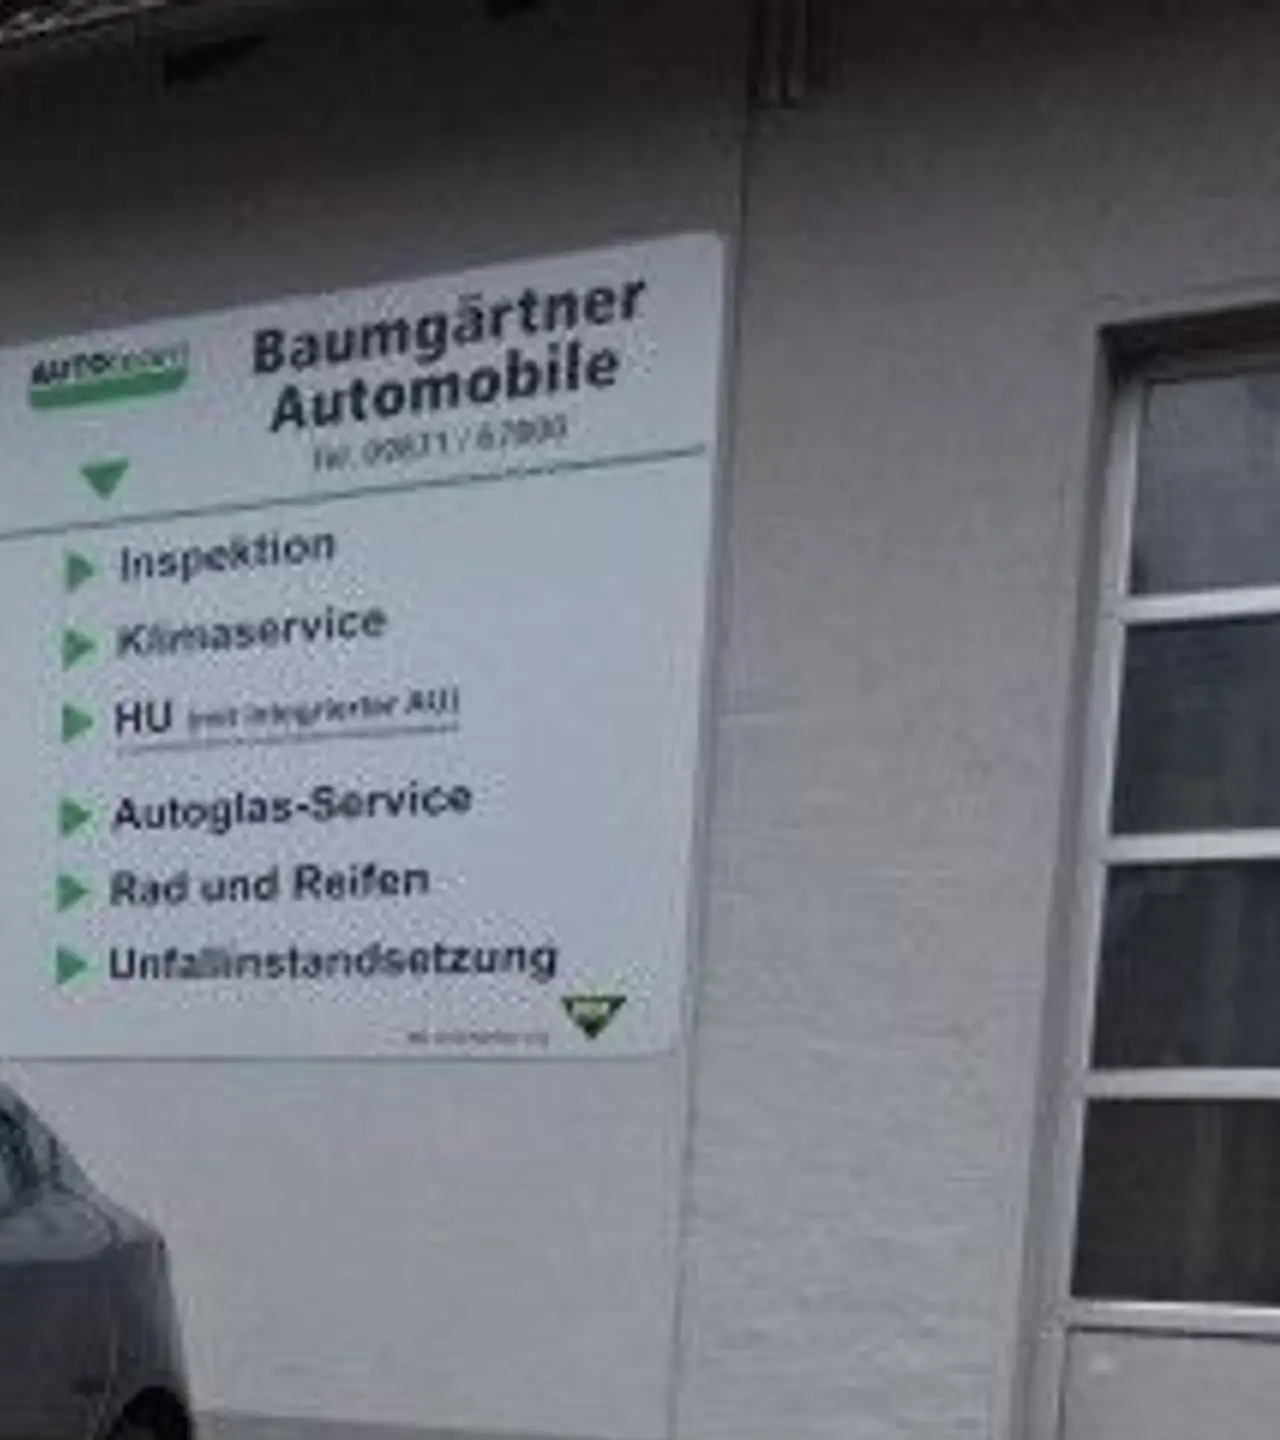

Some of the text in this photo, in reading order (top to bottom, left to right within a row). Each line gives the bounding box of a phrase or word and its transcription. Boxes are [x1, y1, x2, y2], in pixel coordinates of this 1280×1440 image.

[252, 276, 646, 374] Baumgärtner
[269, 341, 621, 433] Automobile
[120, 530, 336, 585] Inspektion
[117, 604, 389, 659] Klimaservice
[116, 698, 173, 736] HU
[112, 779, 474, 837] Autoglas-Service
[109, 861, 431, 907] Rad und Reifen
[108, 941, 558, 984] Unfallinstandsetzung
